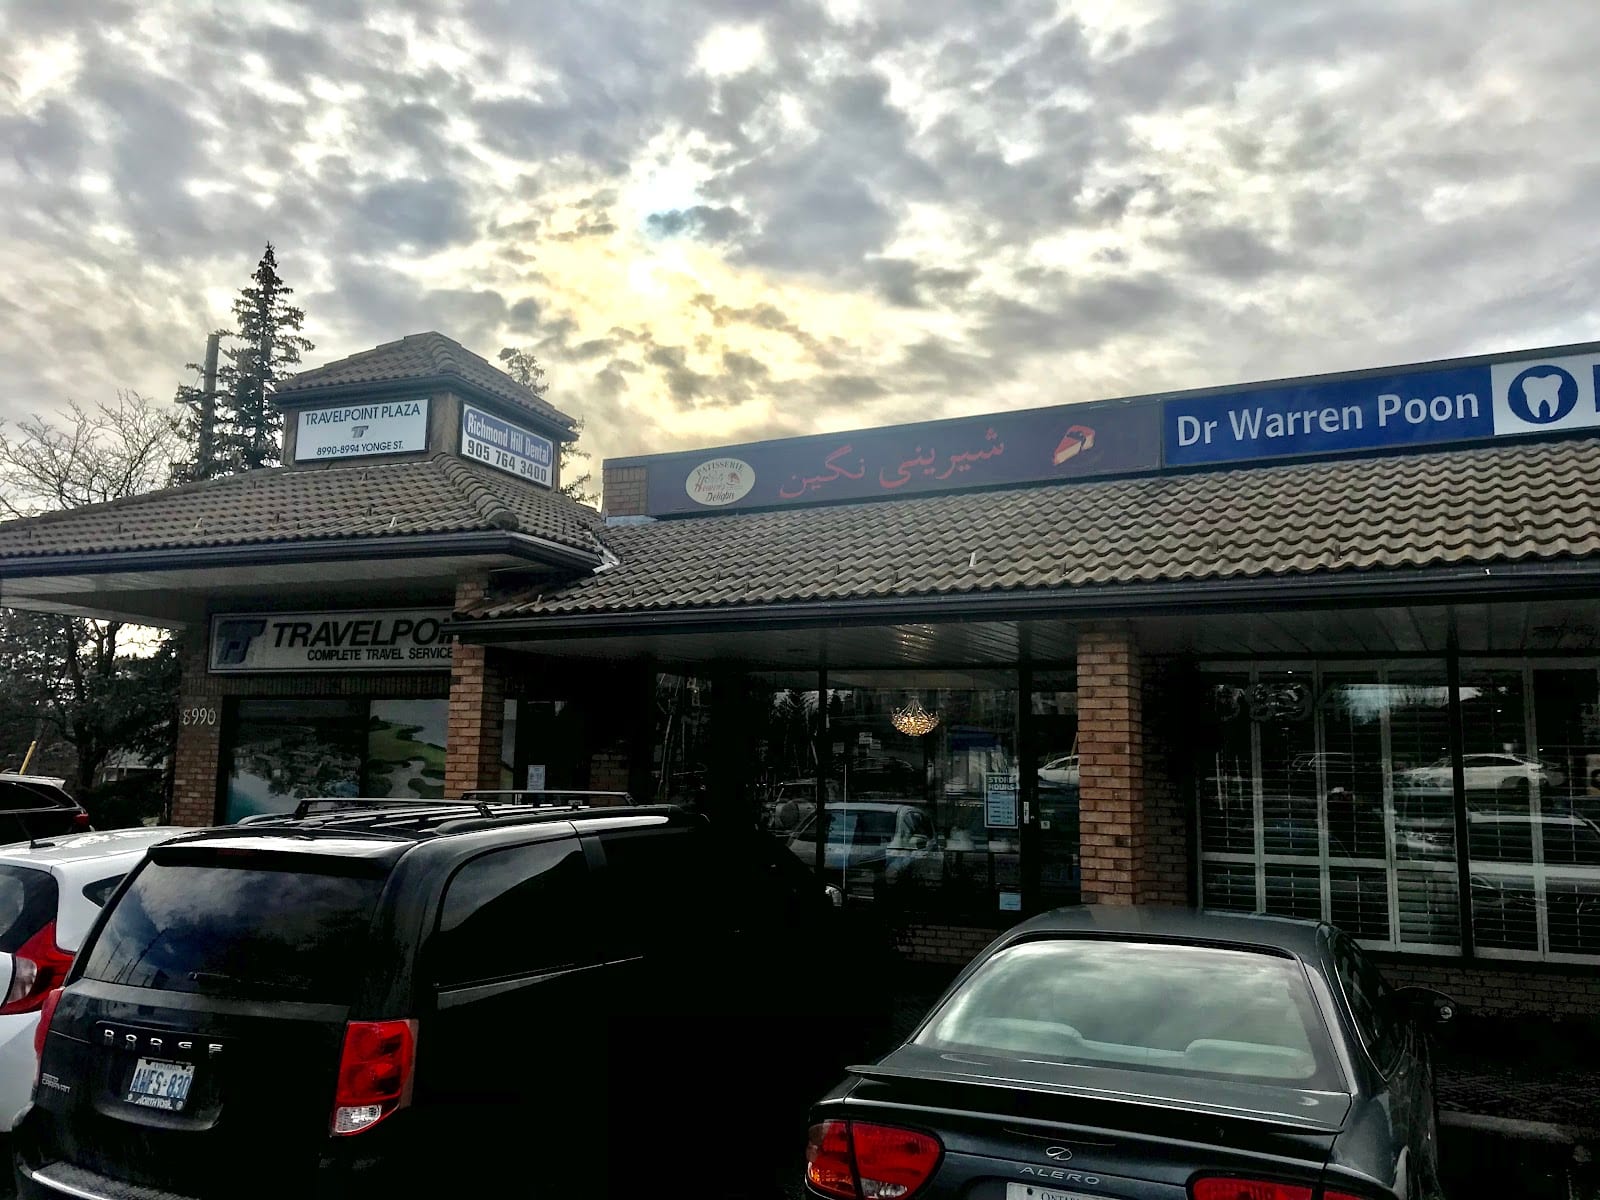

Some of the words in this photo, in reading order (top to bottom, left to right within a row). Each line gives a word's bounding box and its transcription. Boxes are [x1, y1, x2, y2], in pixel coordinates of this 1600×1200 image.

[305, 406, 379, 426] TRAVELPOINT
[381, 403, 421, 419] PLAZA
[1177, 414, 1217, 447] Dr
[1228, 405, 1364, 442] Warren
[1377, 391, 1480, 428] Poon
[361, 441, 391, 452] YONGE
[393, 440, 404, 450] ST.
[467, 412, 508, 448] Richmond
[510, 430, 524, 454] Hill
[525, 435, 549, 464] Dental
[467, 440, 490, 461] 905
[495, 450, 516, 471] 764
[520, 460, 547, 482] 3400
[696, 460, 744, 476] PATISSERIE
[307, 648, 362, 662] COMPLETE
[366, 648, 405, 661] TRAVEL
[987, 776, 1013, 784] STORE
[988, 783, 1015, 791] HOURS
[104, 1028, 224, 1052] DODGE
[1019, 1166, 1100, 1186] ALERO
